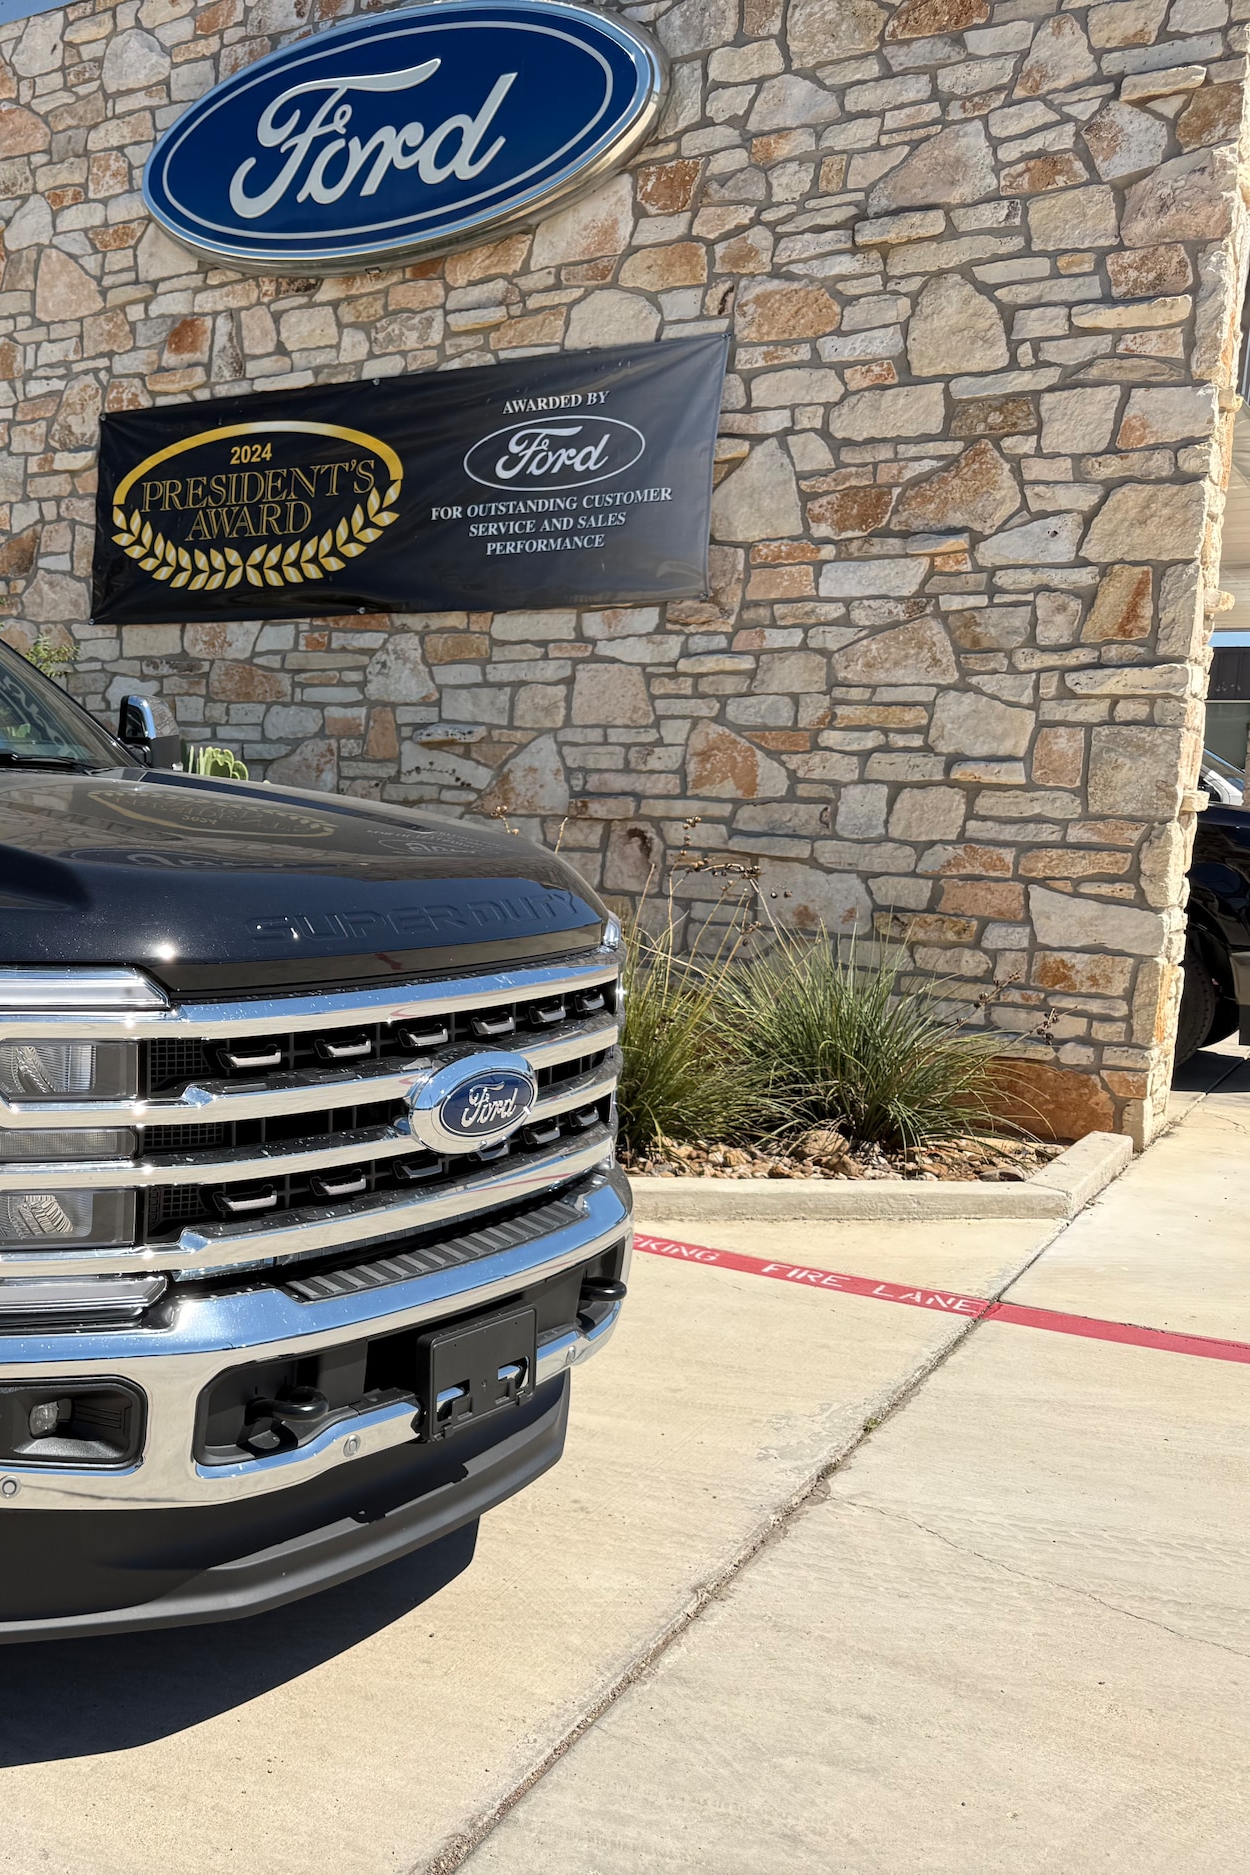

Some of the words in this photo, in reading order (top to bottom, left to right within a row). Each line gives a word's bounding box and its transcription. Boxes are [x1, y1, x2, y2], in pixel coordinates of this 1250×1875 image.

[229, 58, 519, 219] Ford
[502, 393, 583, 415] AWARDED
[586, 390, 611, 406] BY
[230, 442, 272, 465] 2024
[495, 425, 611, 480] Ford
[140, 459, 376, 514] PRESIDENT'S
[431, 506, 463, 521] FOR
[466, 497, 577, 519] OUTSTANDING
[582, 487, 673, 510] CUSTOMER
[184, 500, 312, 542] AWARD
[468, 519, 537, 537] SERVICE
[539, 516, 574, 532] AND
[577, 511, 627, 529] SALES
[485, 533, 606, 556] PERFORMANCE
[244, 904, 468, 944] SUPER
[468, 891, 579, 927] DUTY
[461, 1081, 519, 1128] Ford
[761, 1263, 851, 1288] FIRE
[871, 1284, 984, 1313] LANE
